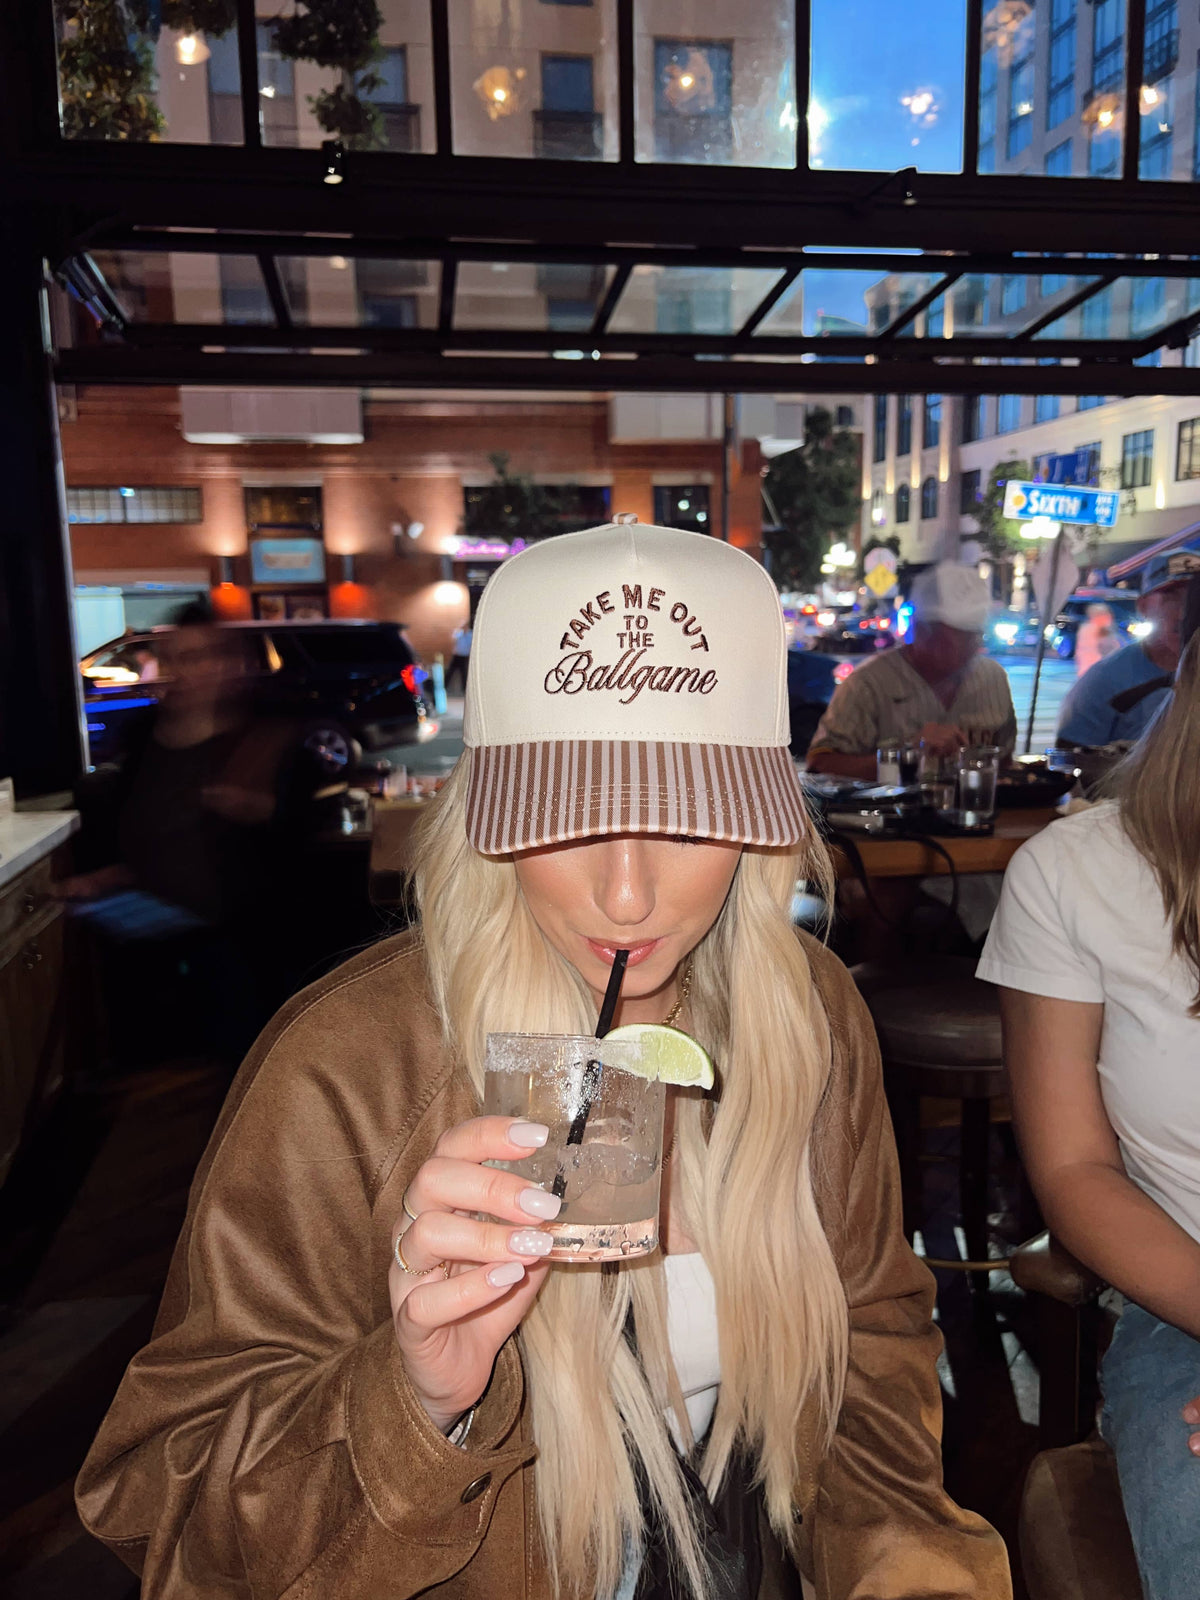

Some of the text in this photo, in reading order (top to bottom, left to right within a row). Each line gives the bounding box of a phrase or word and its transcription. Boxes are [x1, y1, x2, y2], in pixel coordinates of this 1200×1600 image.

[559, 584, 709, 652] TAKE ME OUT
[623, 615, 649, 630] TO
[616, 631, 654, 649] THE
[544, 648, 718, 705] Ballgame
